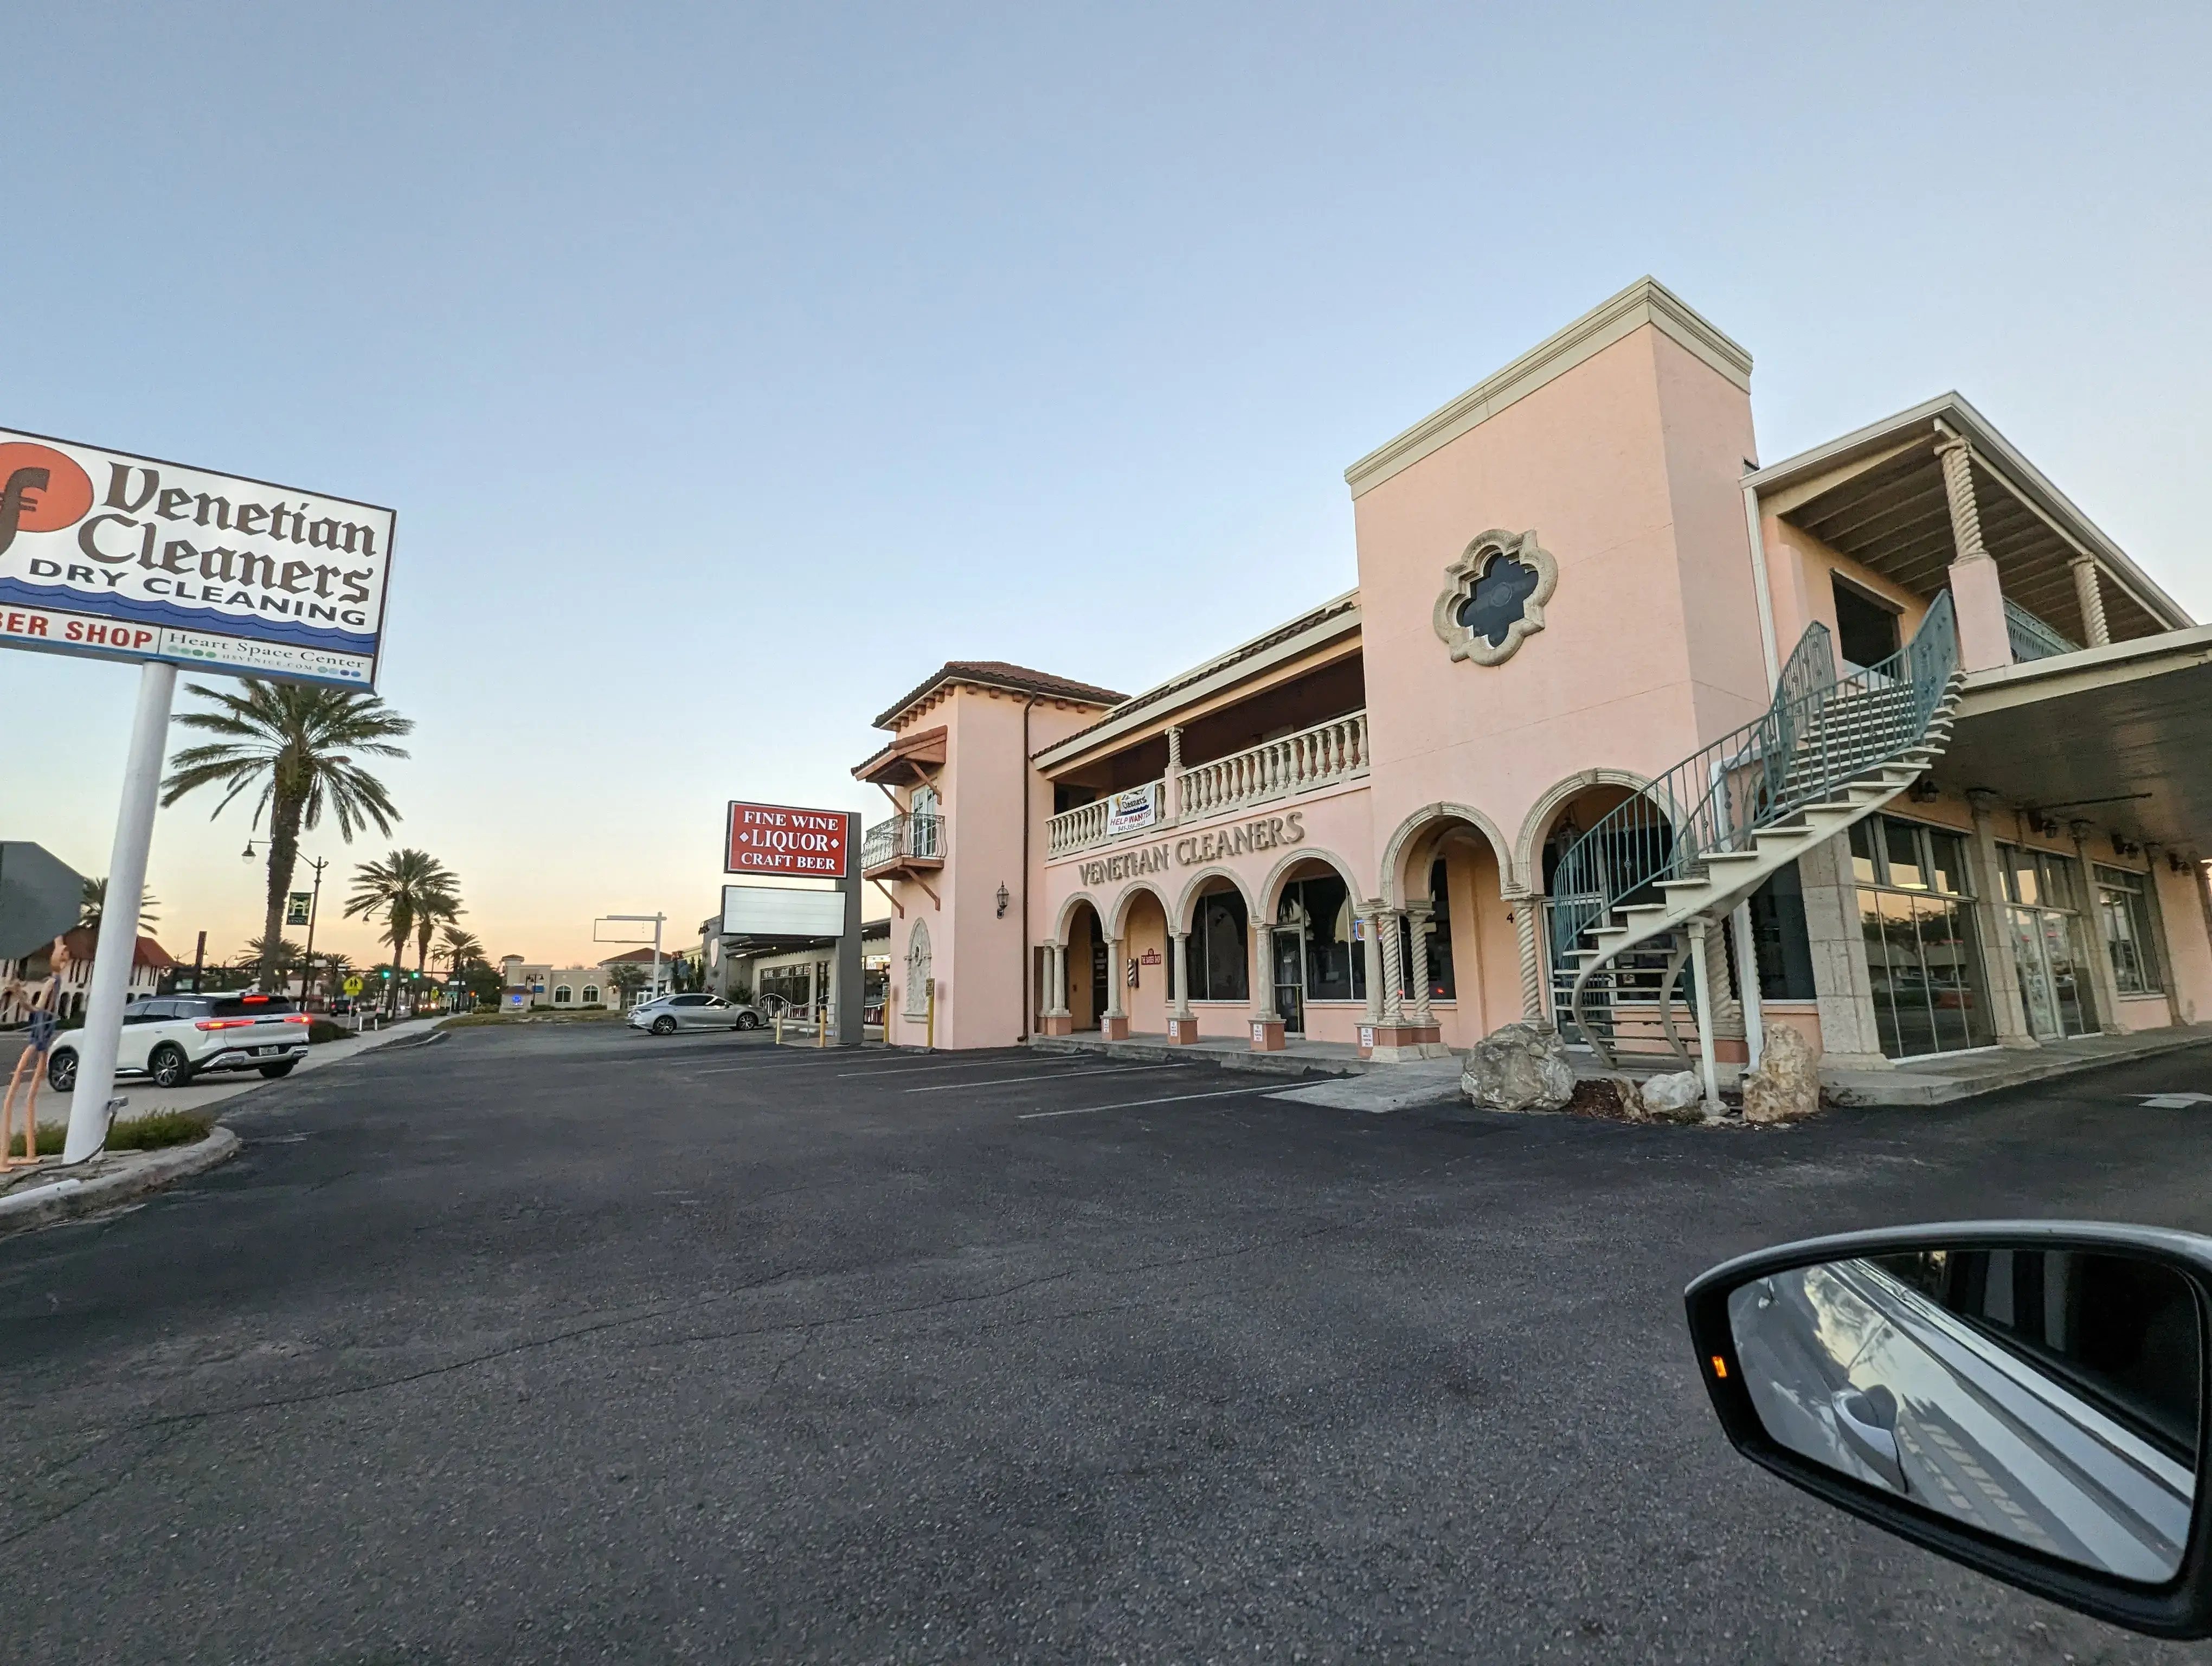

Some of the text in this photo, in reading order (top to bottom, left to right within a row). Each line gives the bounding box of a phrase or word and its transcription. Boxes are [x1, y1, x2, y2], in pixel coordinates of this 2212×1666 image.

[101, 461, 377, 557] Venetian
[78, 513, 374, 604] Cleaners
[29, 558, 366, 626] DRY CLEANING
[0, 611, 153, 649] ER SHOP
[169, 633, 365, 668] Heart Space Center
[1110, 809, 1152, 825] HELP WANTED
[1122, 796, 1147, 809] Cleaners
[743, 811, 839, 831] FINE WINE
[751, 829, 829, 852] LIQUOR
[1078, 811, 1305, 886] VENETIAN CLEANERS
[741, 853, 835, 870] CRAFT BEER
[1507, 913, 1514, 924] 4
